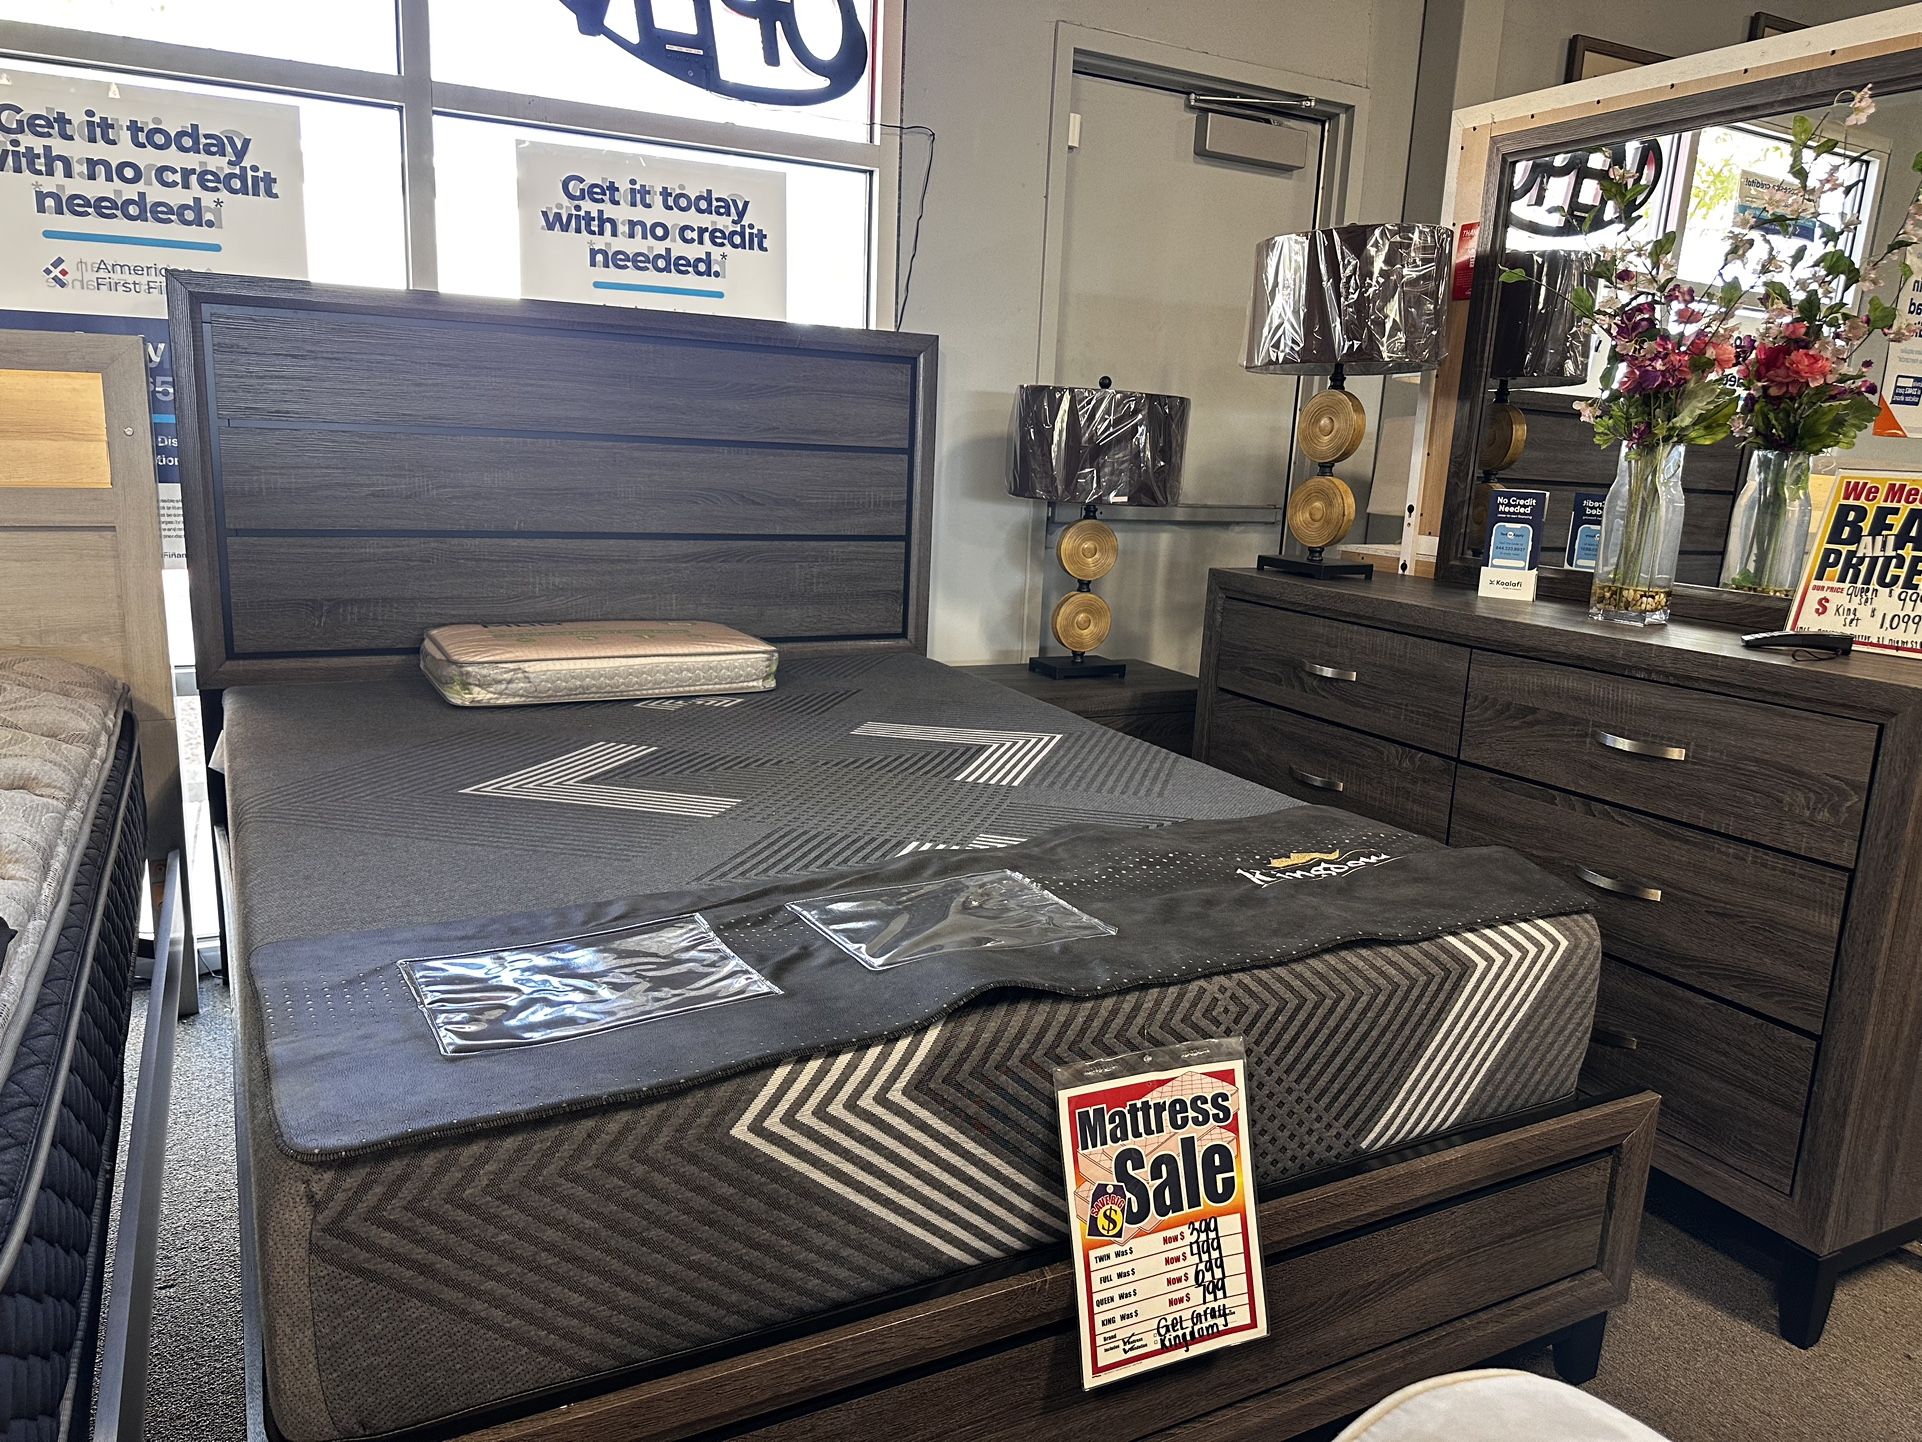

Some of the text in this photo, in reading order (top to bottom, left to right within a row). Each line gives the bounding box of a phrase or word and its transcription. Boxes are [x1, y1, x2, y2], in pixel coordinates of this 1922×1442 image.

[0, 104, 252, 166] Get it today
[87, 157, 143, 185] no
[154, 165, 279, 199] credit
[561, 174, 751, 225] Get it today
[541, 204, 769, 252] with no credit
[95, 259, 168, 277] Americ
[96, 276, 141, 294] First
[1497, 496, 1537, 506] No Credit
[1842, 480, 1880, 502] We
[1855, 534, 1898, 557] ALL
[1496, 579, 1523, 588] Koalafi
[1811, 584, 1845, 594] OUR PRICE
[1814, 596, 1830, 617] $
[1833, 603, 1858, 617] King
[1077, 1091, 1232, 1151] Mattress
[1113, 1136, 1236, 1225] Sale
[1091, 1194, 1126, 1218] SAVE BIG
[1101, 1206, 1118, 1234] $
[1094, 1253, 1111, 1264] TWIN
[1114, 1248, 1128, 1259] Was
[1162, 1234, 1179, 1245] Now
[1179, 1231, 1185, 1241] $
[1188, 1216, 1220, 1243] 399
[1099, 1273, 1113, 1285] FULL
[1116, 1269, 1131, 1280] Was
[1164, 1255, 1181, 1266] Now
[1181, 1251, 1187, 1261] $
[1095, 1295, 1115, 1308] QUEEN
[1118, 1290, 1132, 1301] Was
[1166, 1276, 1183, 1287] Now
[1183, 1272, 1189, 1282] $
[1101, 1315, 1116, 1328] KING
[1119, 1311, 1134, 1322] Was
[1168, 1297, 1185, 1308] Now
[1185, 1292, 1191, 1302] $
